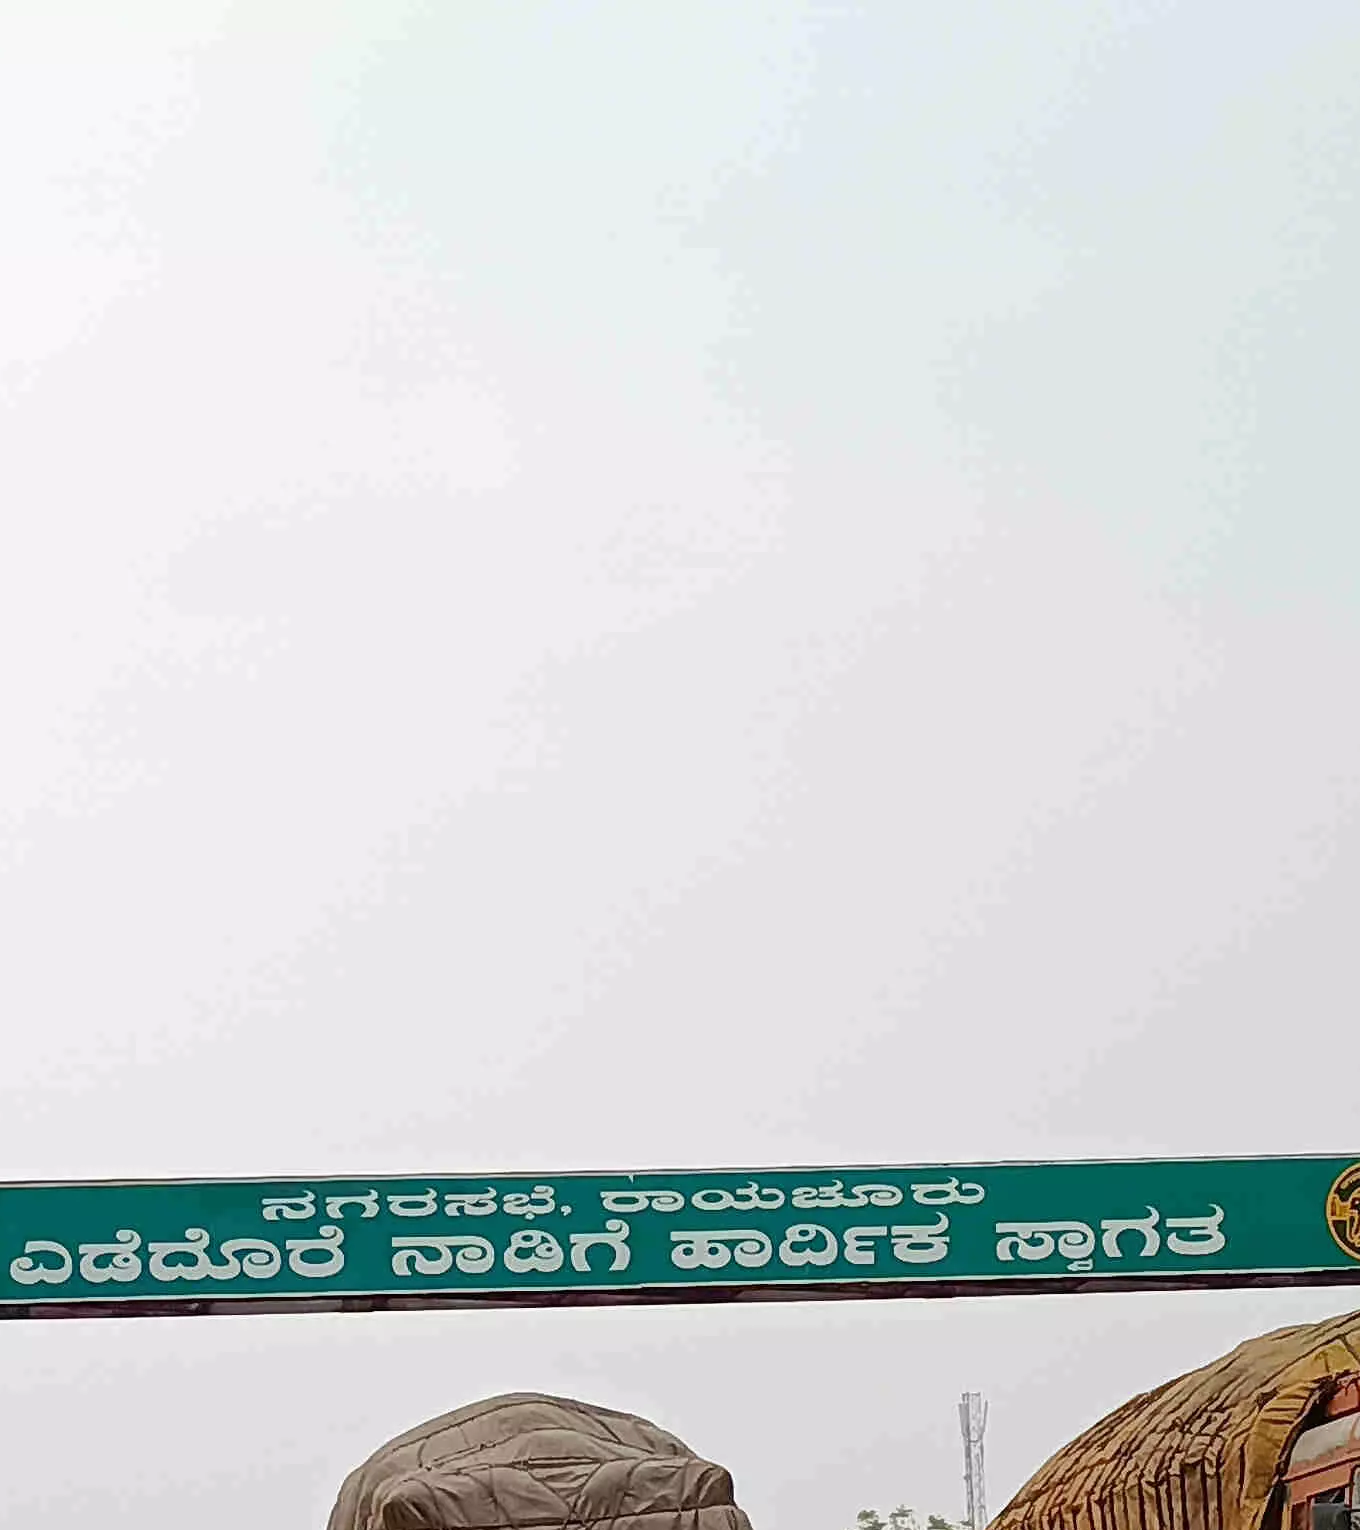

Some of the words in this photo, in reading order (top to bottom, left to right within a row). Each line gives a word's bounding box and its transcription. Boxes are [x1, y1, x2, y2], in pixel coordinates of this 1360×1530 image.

[262, 1185, 571, 1222] ನಗರಸಭೆ,
[599, 1175, 986, 1214] ರಾಯಚೂರು
[9, 1226, 345, 1285] ಎಡೆದೊರೆ
[391, 1218, 632, 1277] ನಾಡಿಗೆ
[669, 1212, 951, 1270] ಹಾರ್ದಿಕ
[995, 1203, 1226, 1272] ಸ್ವಾಗತ
